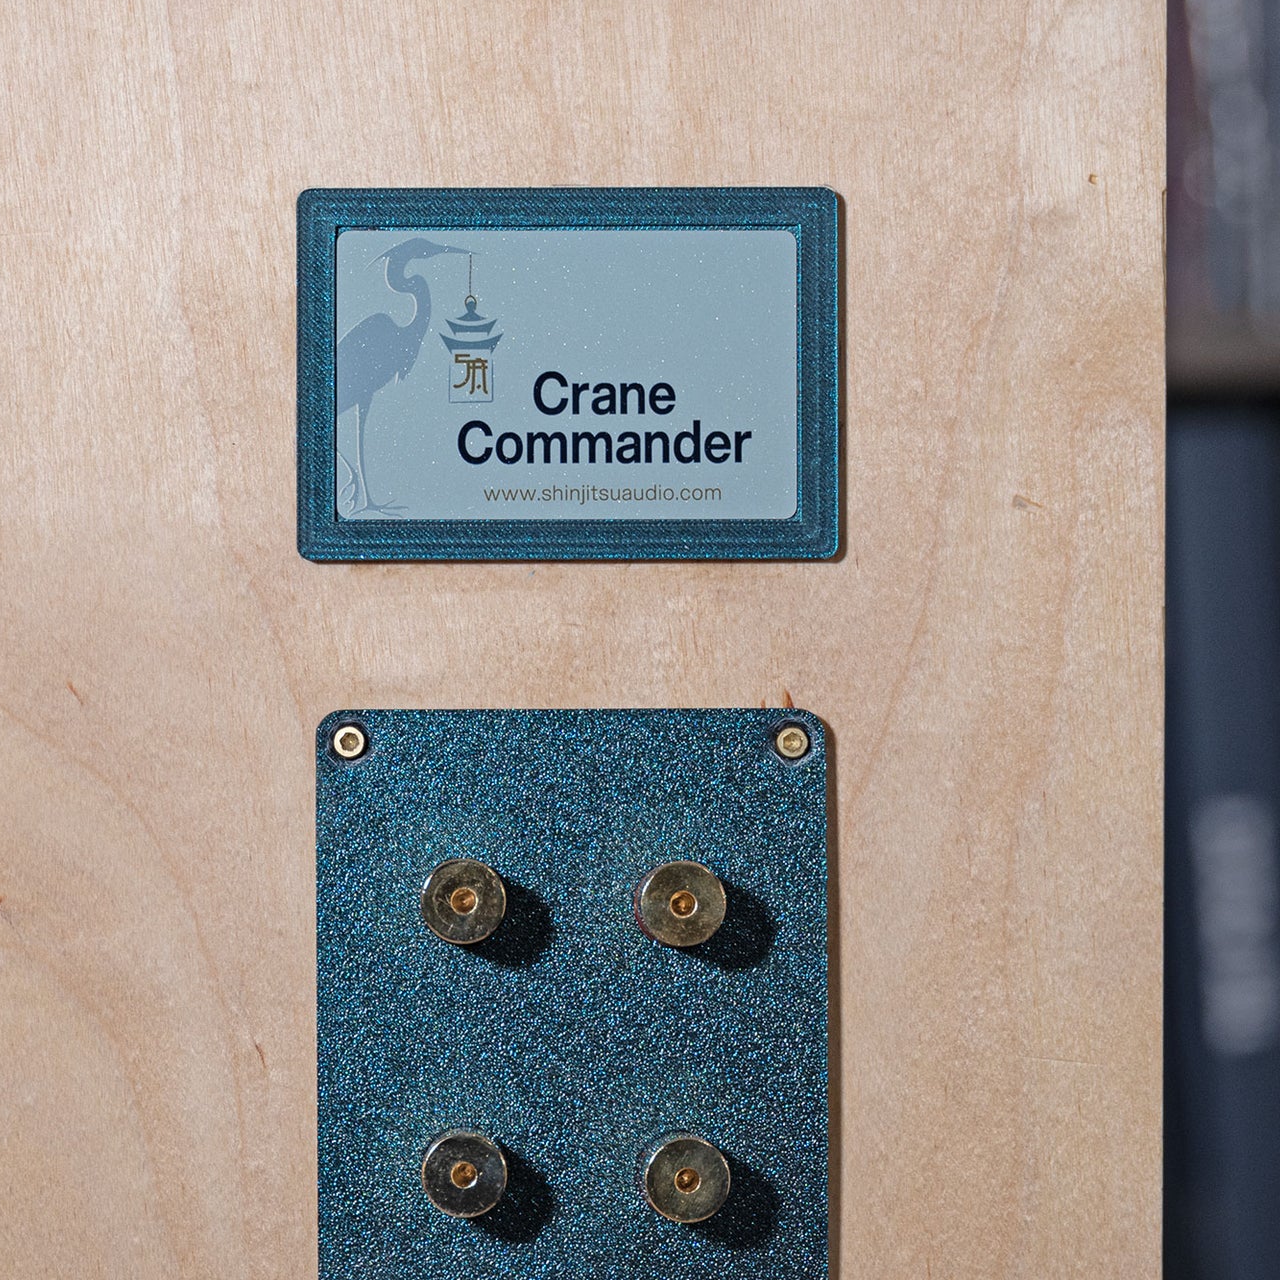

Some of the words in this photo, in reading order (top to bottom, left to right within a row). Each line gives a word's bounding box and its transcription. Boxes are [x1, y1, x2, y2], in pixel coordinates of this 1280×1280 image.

[533, 370, 676, 416] Crane
[457, 419, 752, 465] Commander
[483, 483, 722, 506] www.shinjitsuaudio.com
